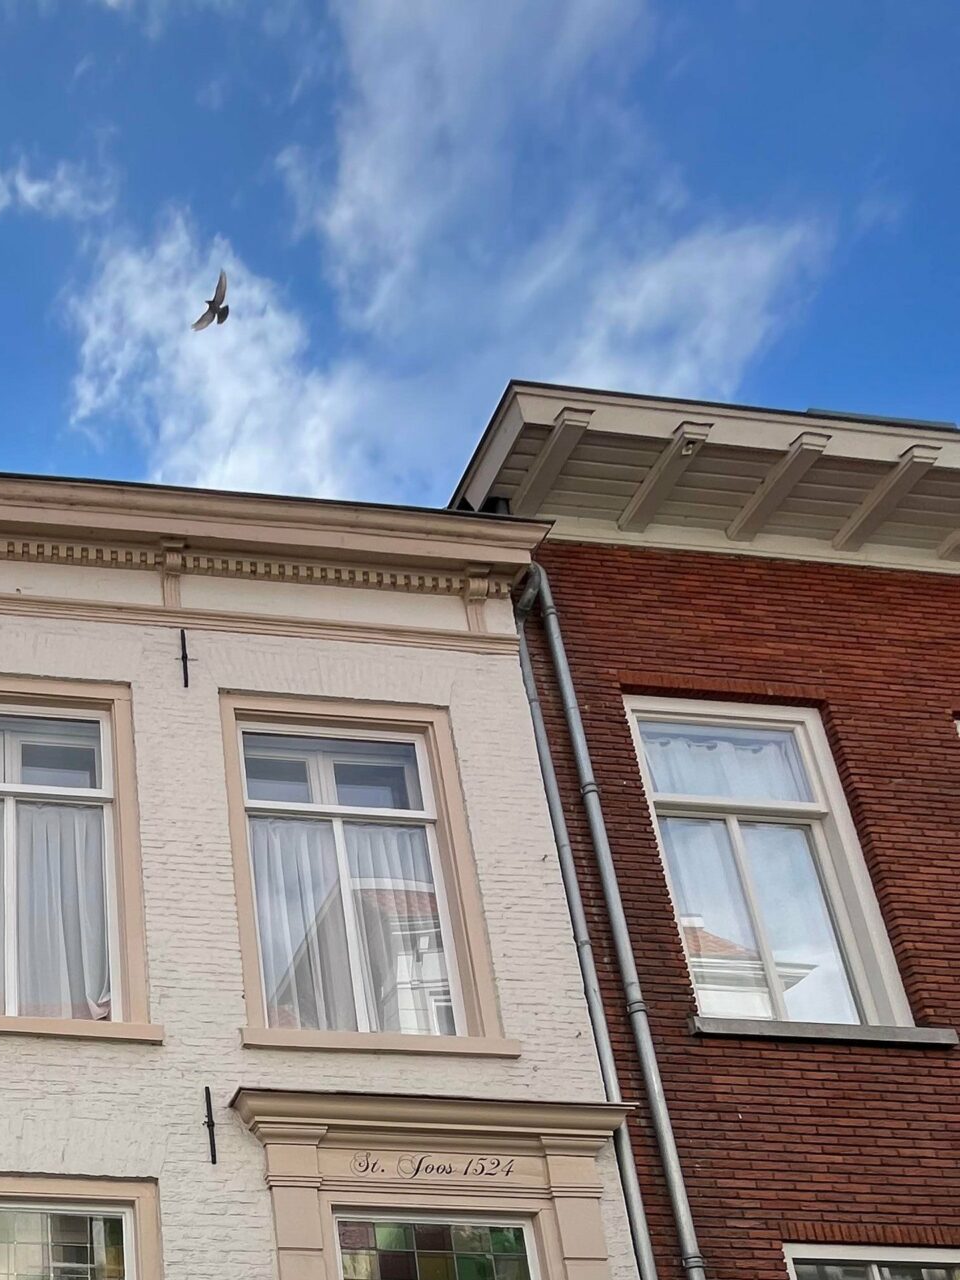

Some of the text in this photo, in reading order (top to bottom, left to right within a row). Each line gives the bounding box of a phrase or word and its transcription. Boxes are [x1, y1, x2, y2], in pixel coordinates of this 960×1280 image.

[350, 1152, 515, 1179] St. Joos 1524
